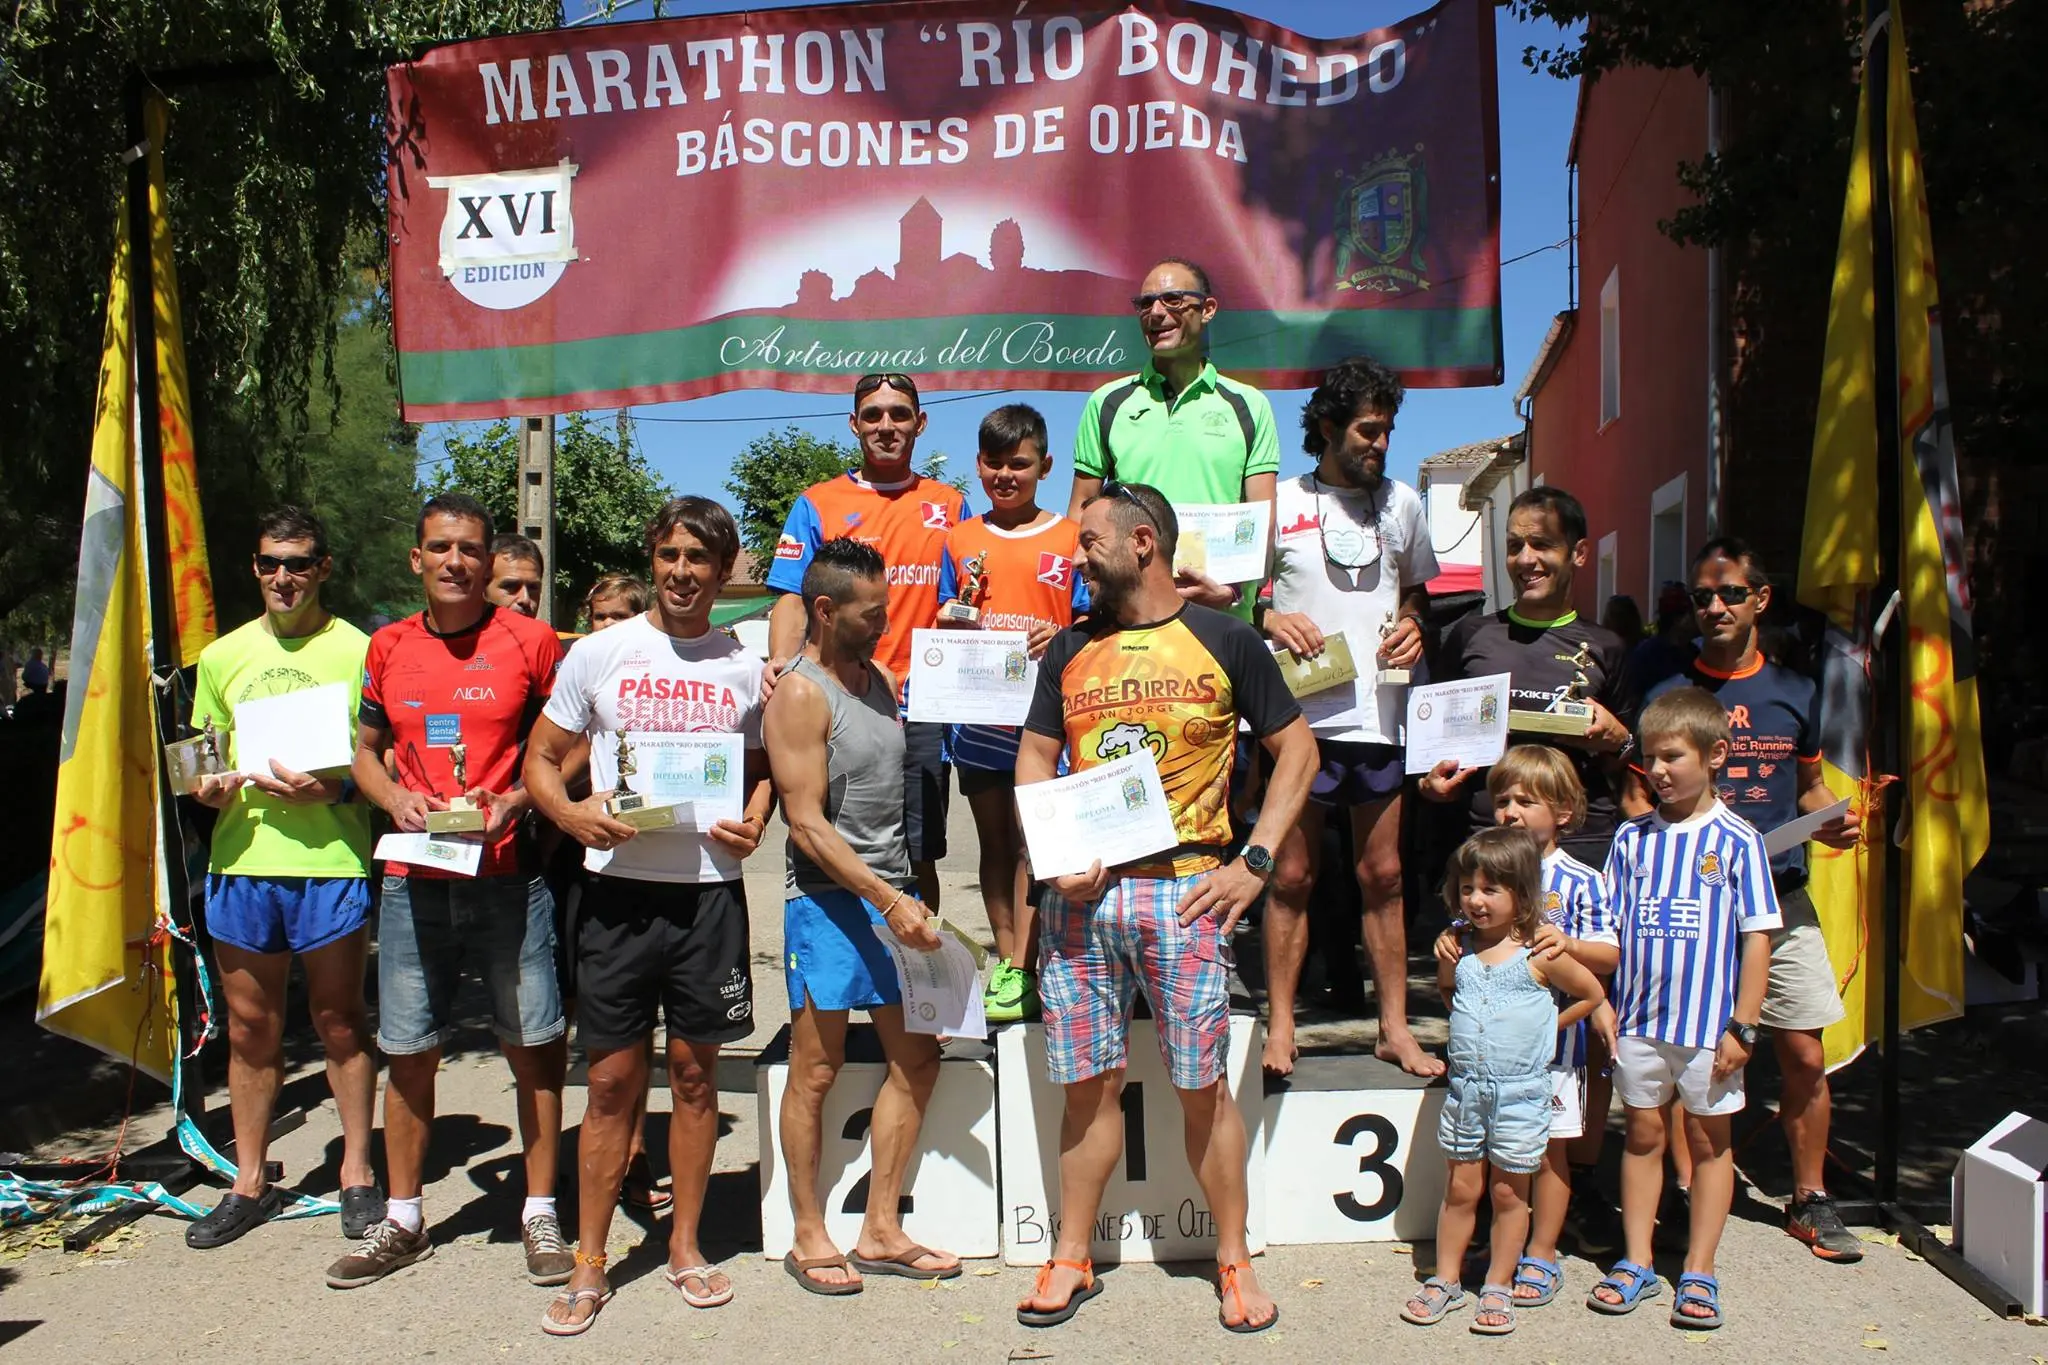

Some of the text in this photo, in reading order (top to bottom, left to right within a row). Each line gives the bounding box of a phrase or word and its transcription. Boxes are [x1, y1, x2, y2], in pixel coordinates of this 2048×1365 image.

[478, 28, 886, 125] MARATHON
[676, 101, 1249, 177] BÁSCONES DE OJEDA
[456, 190, 557, 239] XVI
[720, 321, 1128, 369] Artesanas del Boedo
[618, 672, 737, 709] PÁSATE A
[615, 697, 741, 730] SERRANO
[1089, 704, 1175, 721] SAN JORGE
[640, 741, 676, 749] MARATÓN
[653, 772, 694, 781] DIPLOMA
[1637, 927, 1698, 940] qbao.com
[1119, 1081, 1147, 1182] 1
[1332, 1114, 1403, 1223] 3
[1142, 1213, 1166, 1240] DE
